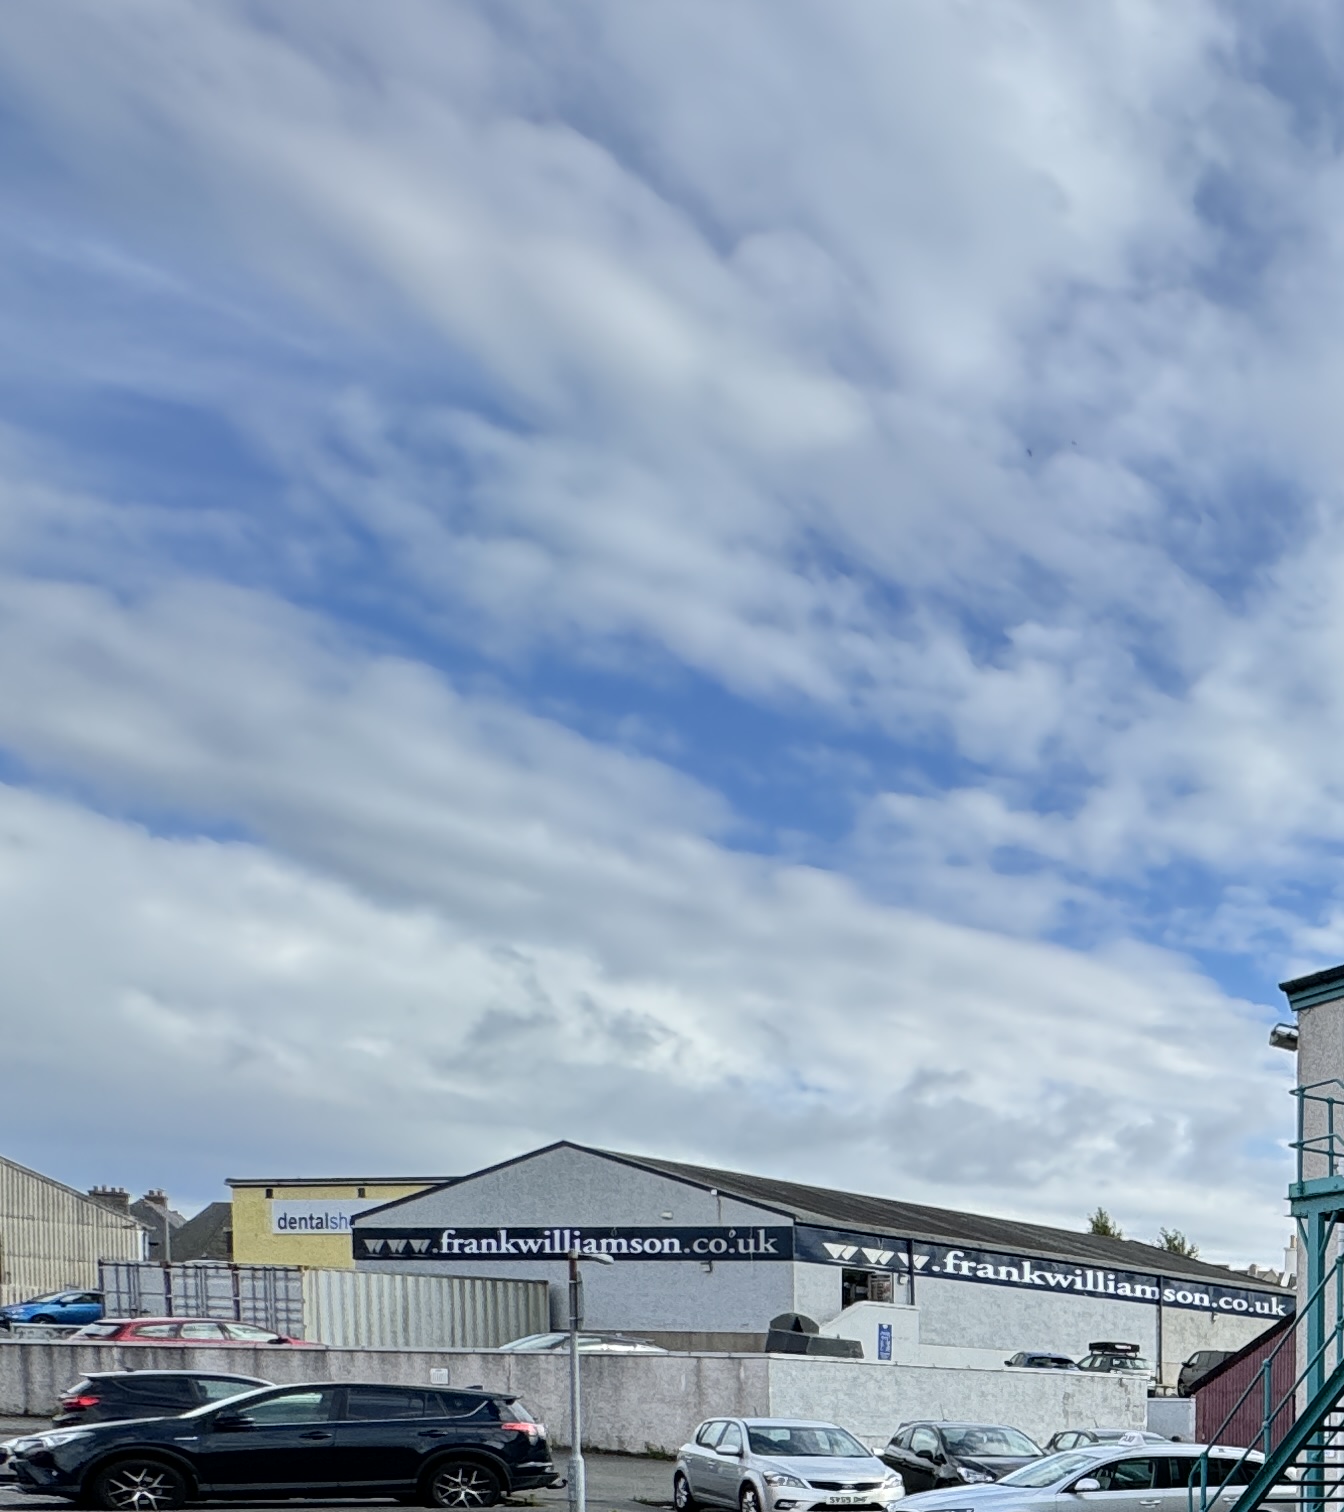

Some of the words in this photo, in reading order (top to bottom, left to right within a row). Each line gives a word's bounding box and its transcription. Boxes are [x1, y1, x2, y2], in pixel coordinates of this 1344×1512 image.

[277, 1212, 354, 1231] dentalsh
[362, 1228, 779, 1257] www.frankwilliamson.co.uk
[822, 1242, 1287, 1317] www.frankwilliamson.co.uk
